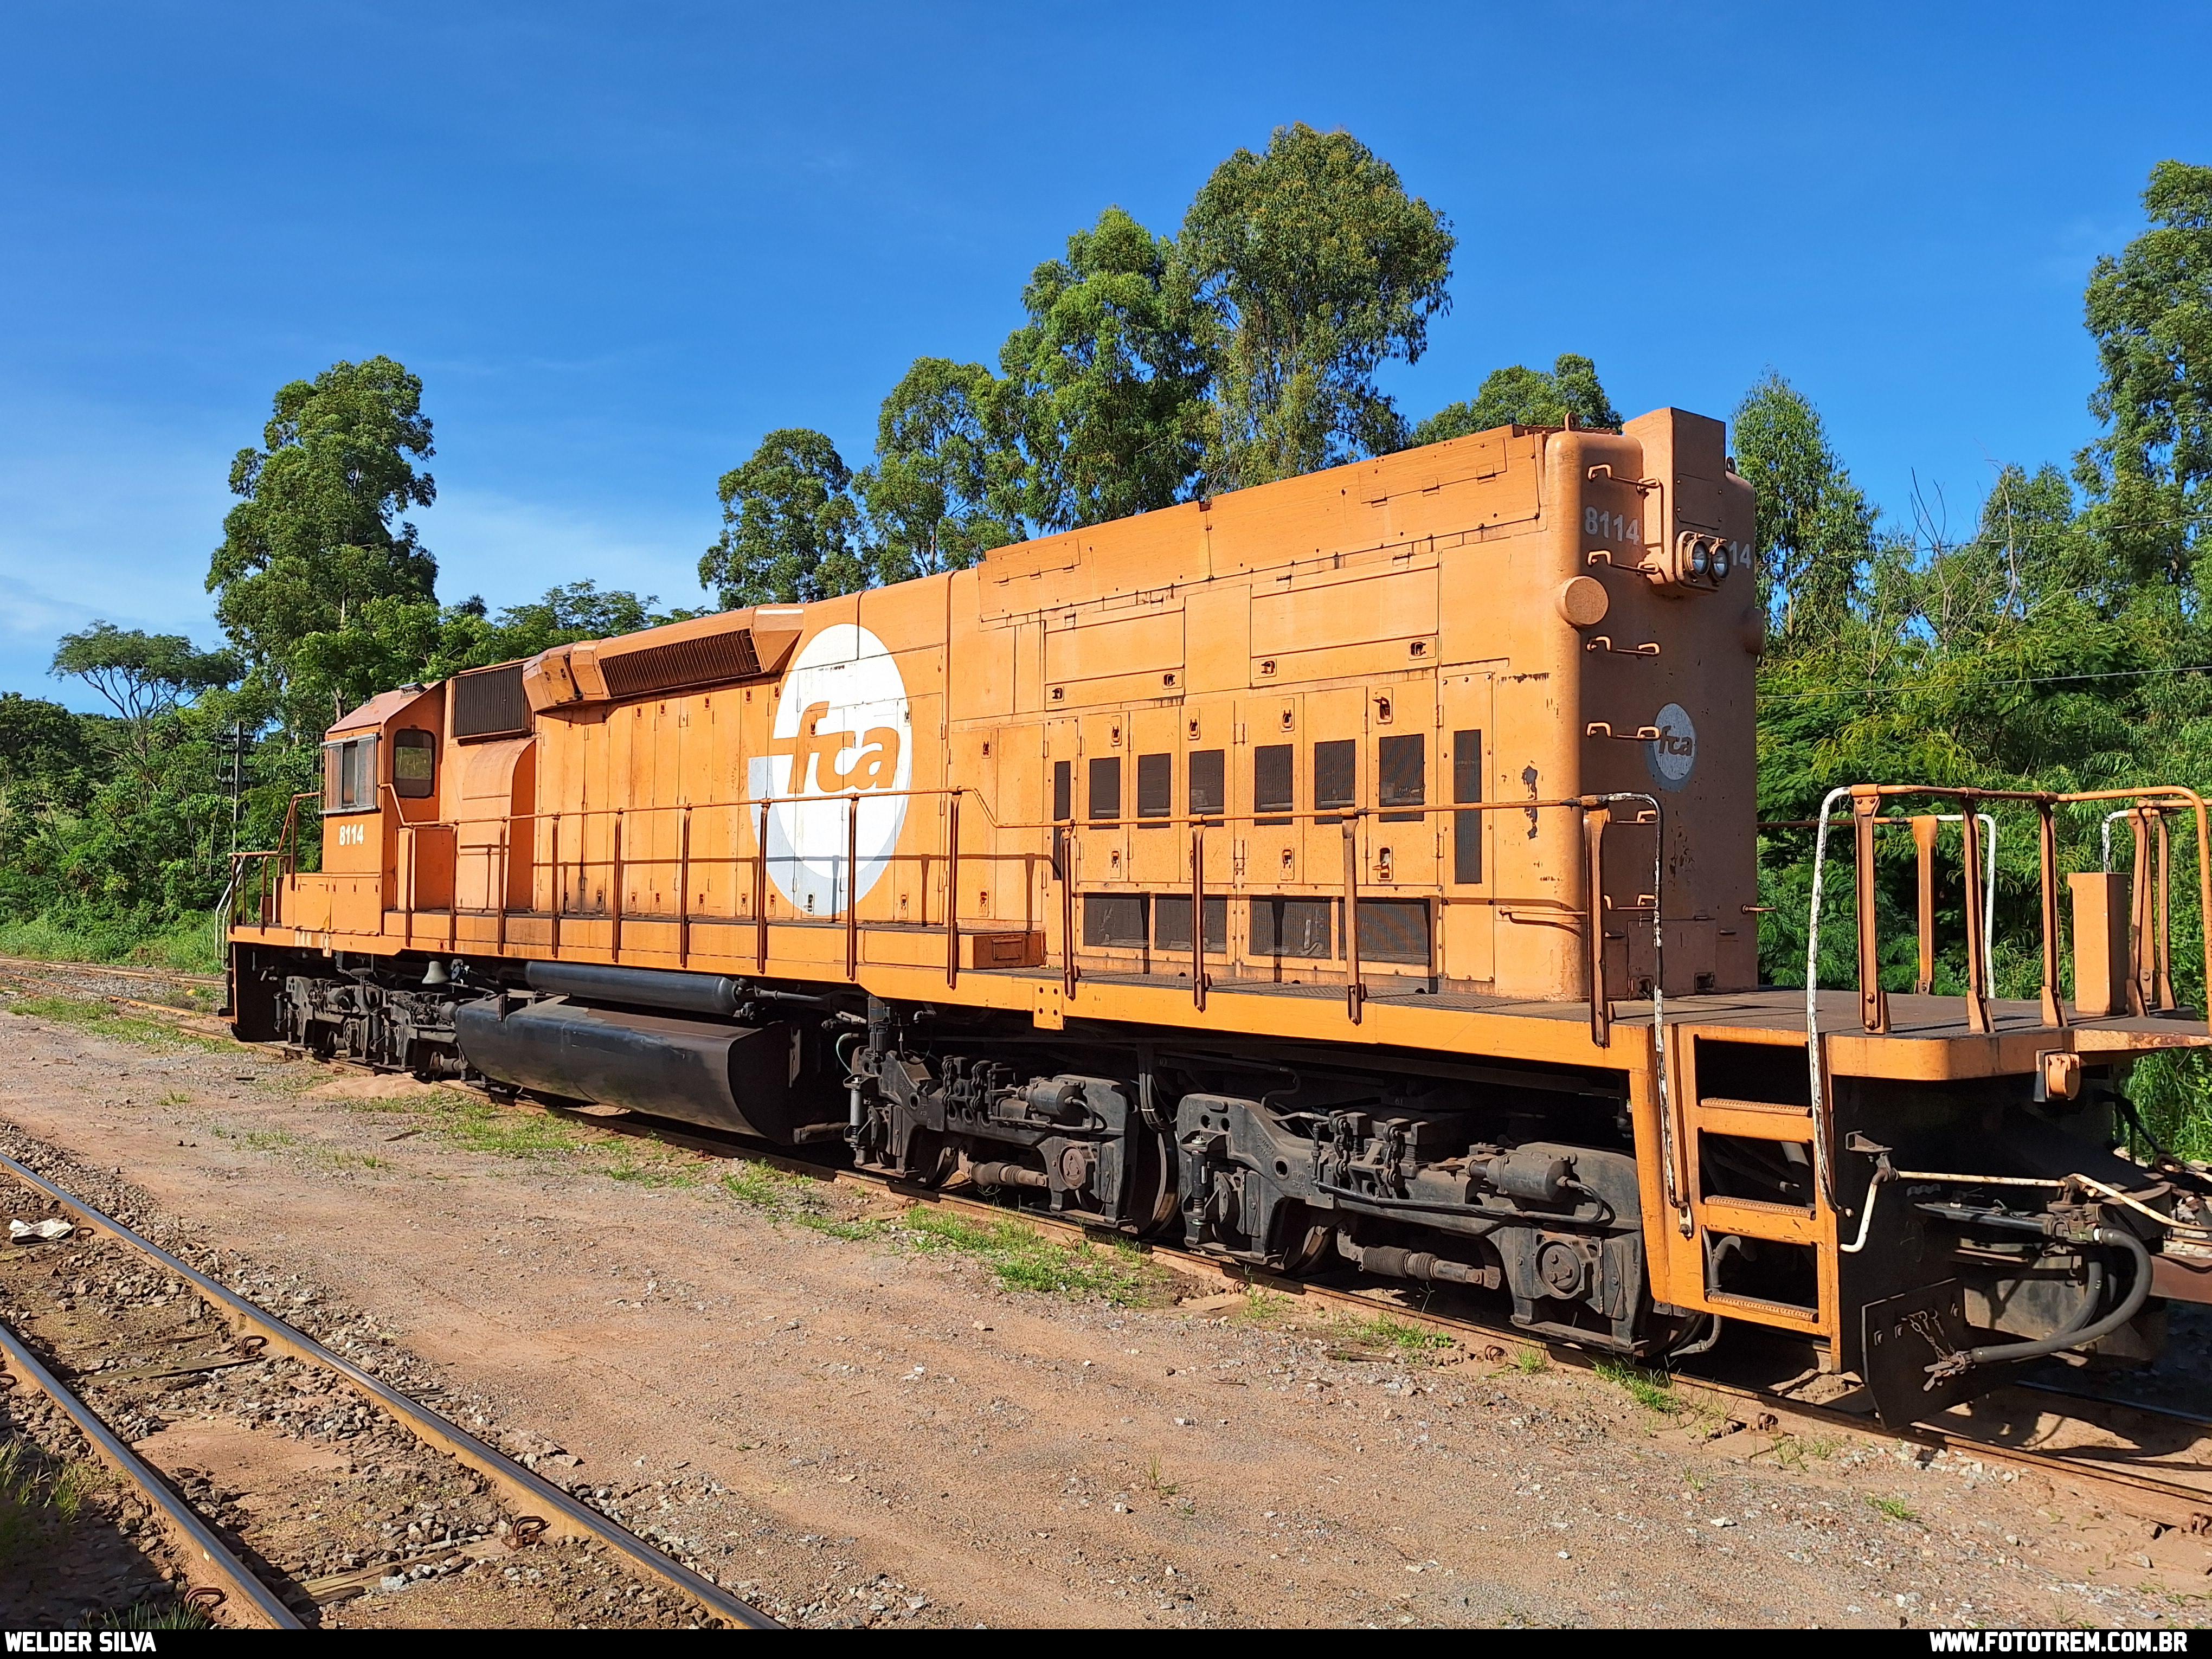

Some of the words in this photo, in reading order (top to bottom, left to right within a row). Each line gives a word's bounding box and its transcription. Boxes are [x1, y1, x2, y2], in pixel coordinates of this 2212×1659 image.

[1584, 506, 1639, 545] 8114
[787, 700, 901, 793] fca
[1658, 725, 1693, 756] fca
[339, 823, 364, 846] 8114
